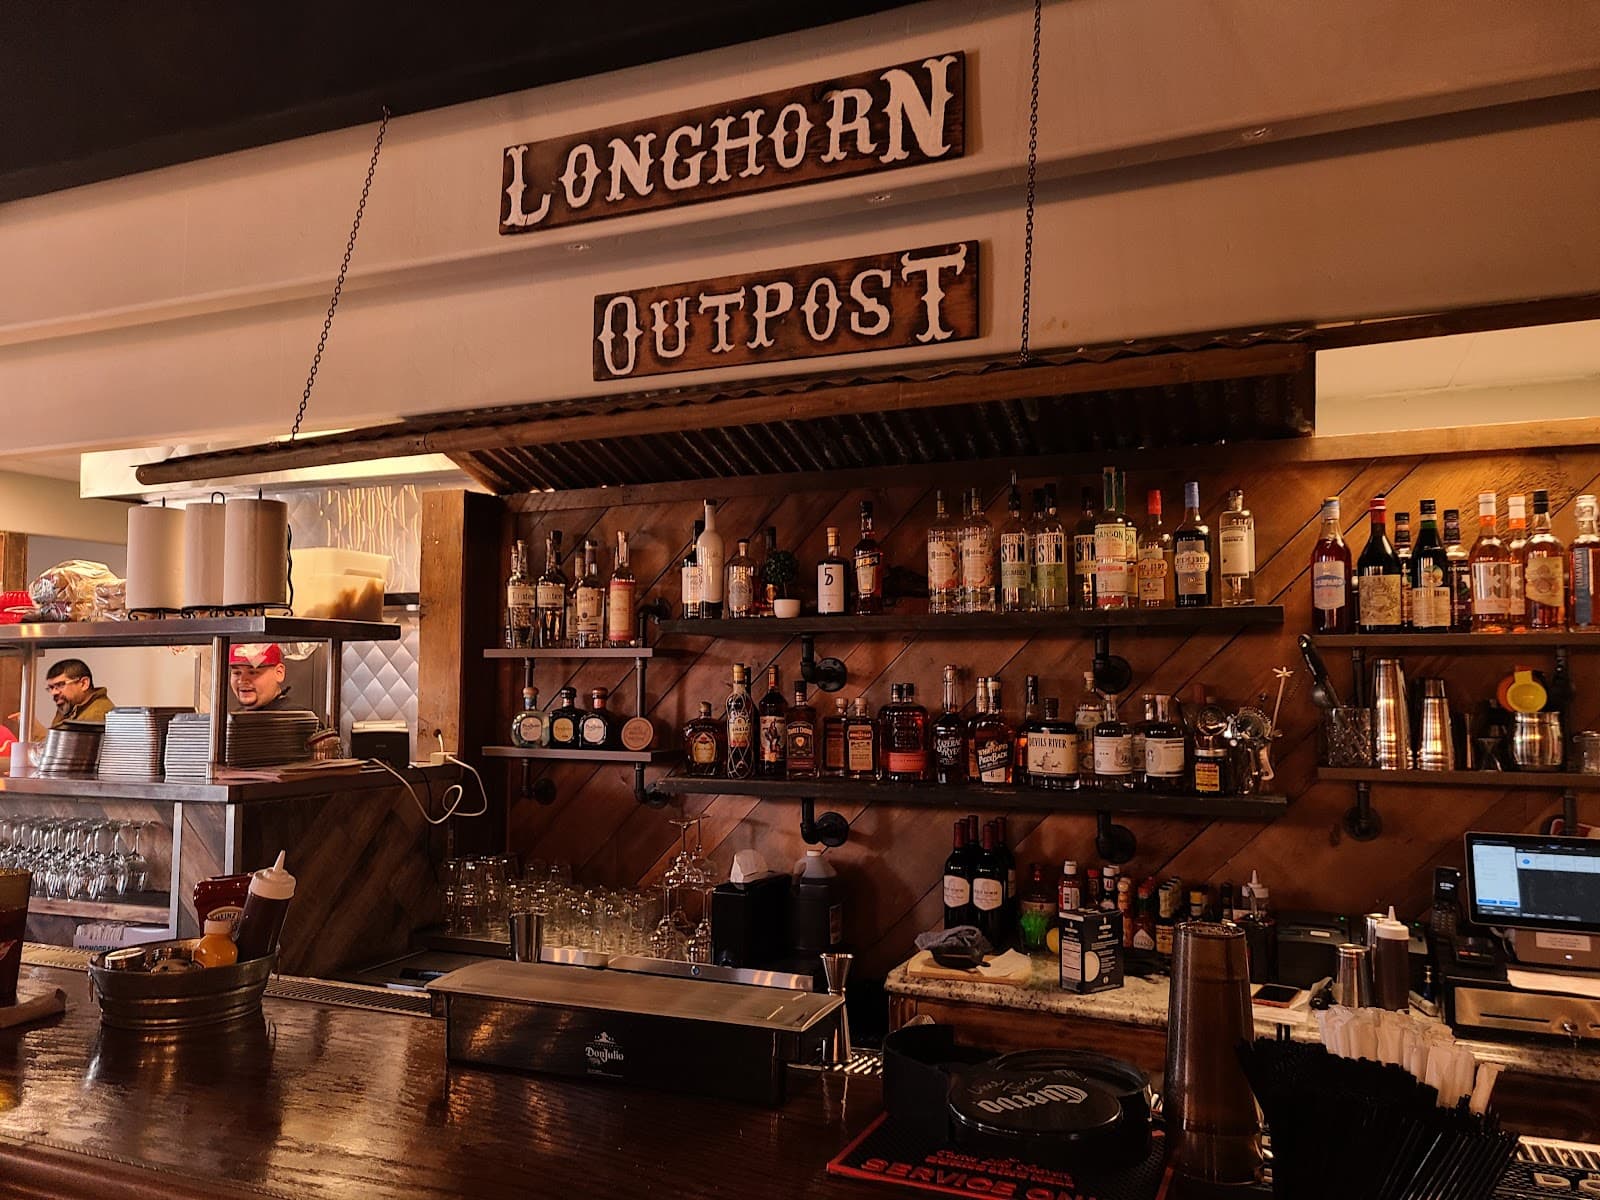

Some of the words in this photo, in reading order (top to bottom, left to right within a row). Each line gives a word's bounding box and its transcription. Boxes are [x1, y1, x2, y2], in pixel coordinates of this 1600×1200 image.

[503, 55, 958, 228] LONGHORN
[598, 244, 967, 376] OUTPOST
[1048, 737, 1067, 748] RIVER
[860, 1157, 1018, 1197] SERVICE
